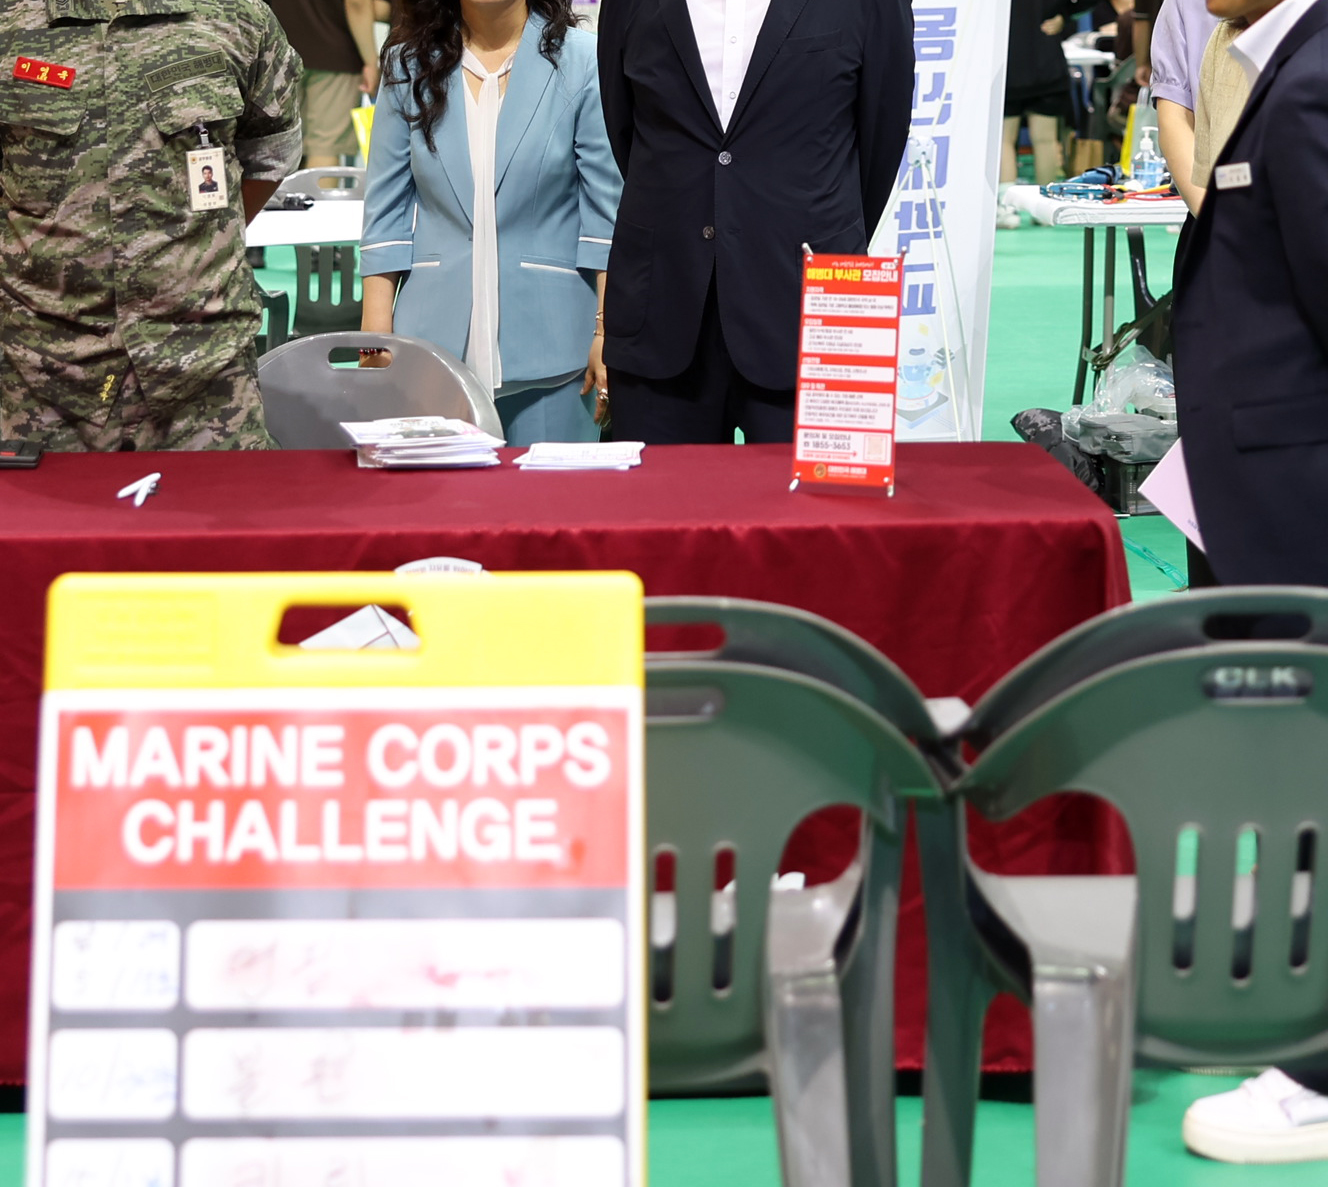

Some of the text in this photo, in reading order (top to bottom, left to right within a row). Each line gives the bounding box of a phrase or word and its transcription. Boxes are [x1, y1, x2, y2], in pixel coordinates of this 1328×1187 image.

[149, 63, 194, 84] 대한민국
[193, 55, 222, 70] 해병대
[71, 721, 612, 789] MARINE CORPS
[122, 798, 564, 864] CHALLENGE
